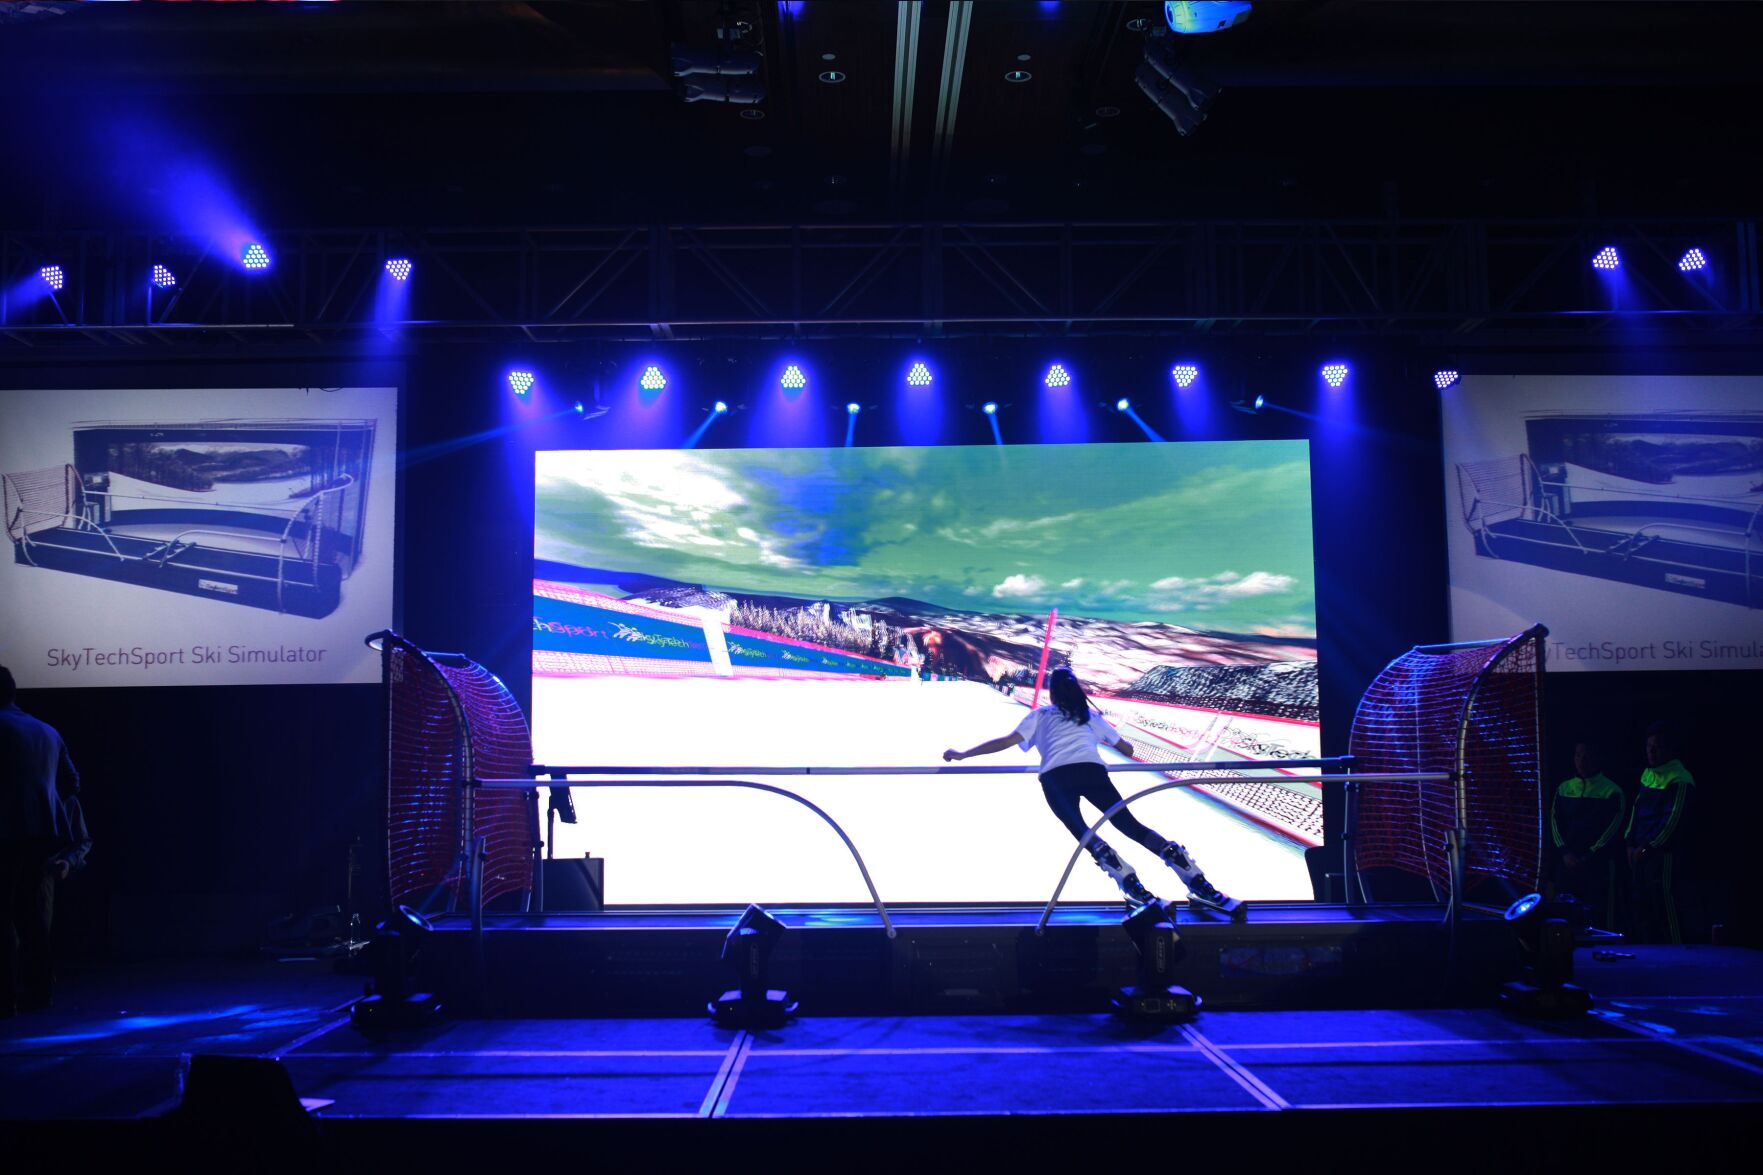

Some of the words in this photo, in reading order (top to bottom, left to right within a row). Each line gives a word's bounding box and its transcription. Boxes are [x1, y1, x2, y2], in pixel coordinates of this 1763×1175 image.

[47, 648, 184, 670] SkyTechSport
[191, 646, 221, 664] Ski
[228, 645, 328, 663] Simulator
[1663, 640, 1693, 659] Ski
